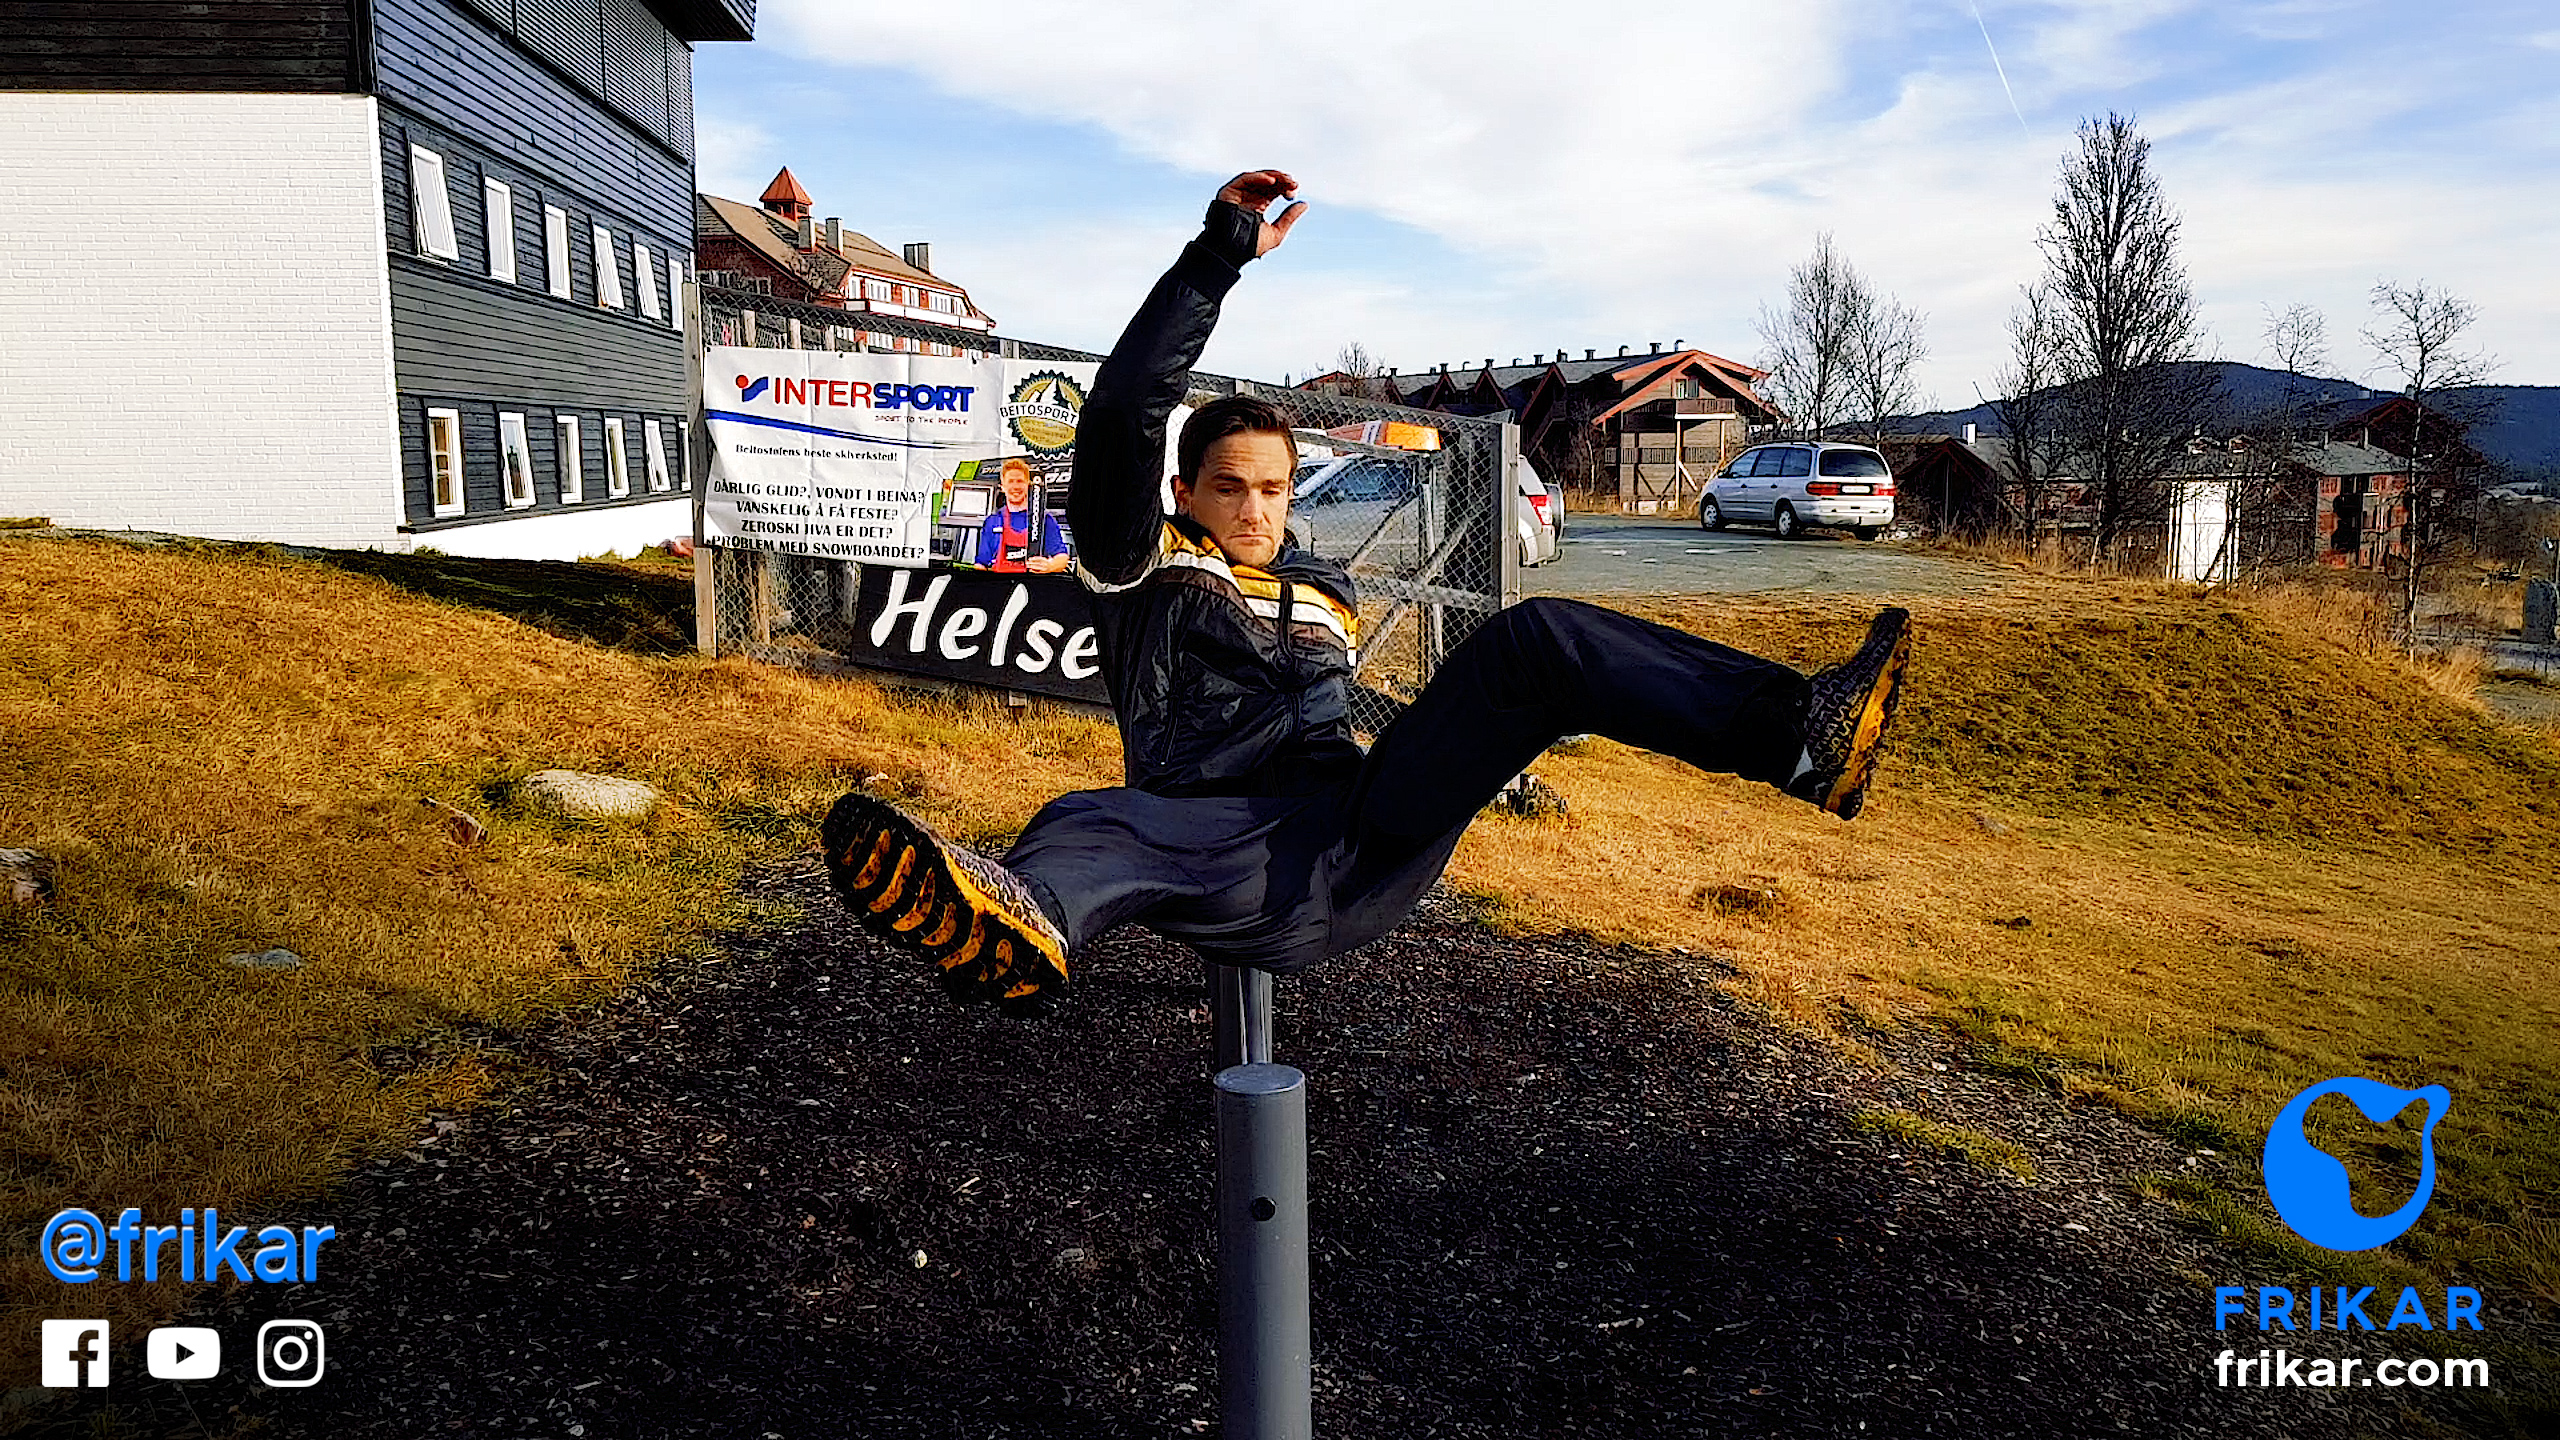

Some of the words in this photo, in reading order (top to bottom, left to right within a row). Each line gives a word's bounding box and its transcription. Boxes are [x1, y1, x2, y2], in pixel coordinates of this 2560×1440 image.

[774, 376, 975, 412] INTERSPORT
[999, 403, 1077, 424] BEITOSPORT
[804, 448, 831, 459] beste
[714, 478, 761, 495] DÅRLIG
[816, 487, 862, 500] VONDT
[867, 489, 871, 501] I
[877, 490, 925, 503] BEINA?
[736, 500, 810, 517] VANSKELIG
[815, 502, 824, 517] Å
[829, 503, 845, 518] FÅ
[850, 507, 898, 520] FESTE?
[741, 519, 800, 535] ZEROSKI
[836, 525, 854, 537] ER
[859, 526, 893, 539] DET?
[712, 535, 775, 552] PROBLEM
[779, 540, 809, 554] MED
[812, 542, 925, 559] SNOWBOARDET?
[871, 570, 1101, 680] Helse
